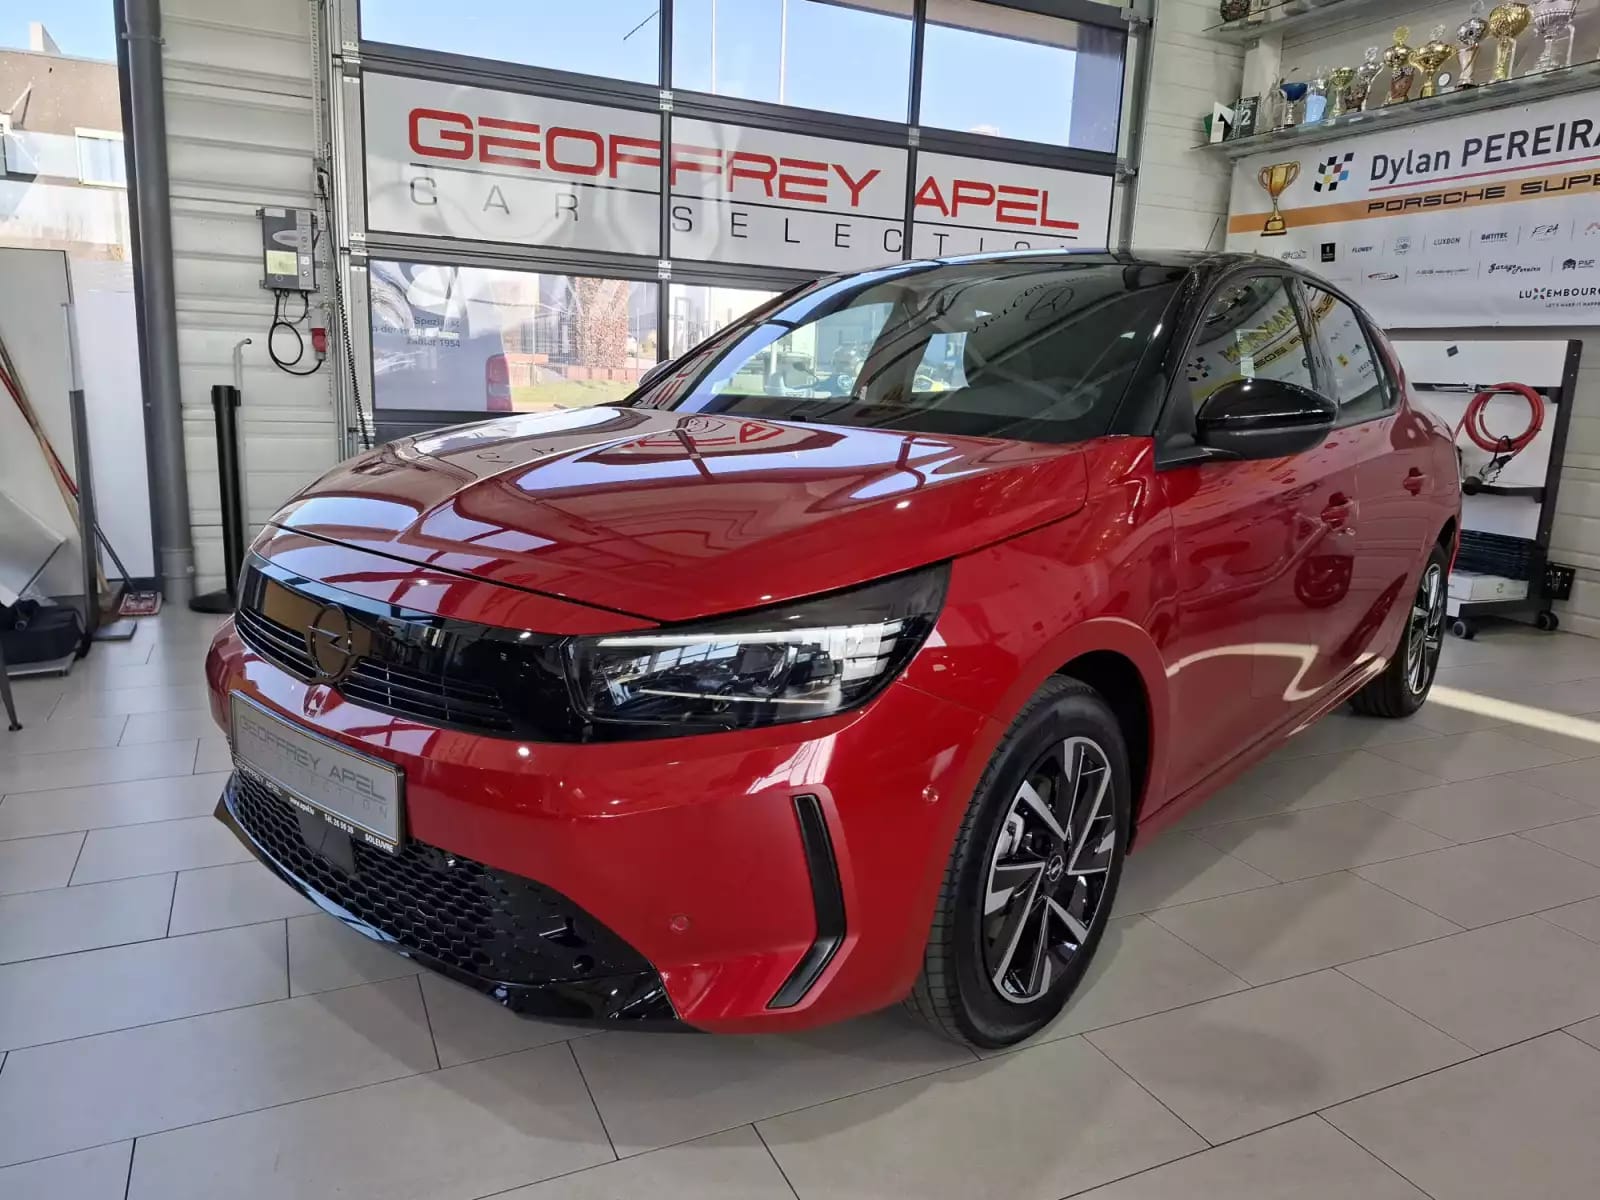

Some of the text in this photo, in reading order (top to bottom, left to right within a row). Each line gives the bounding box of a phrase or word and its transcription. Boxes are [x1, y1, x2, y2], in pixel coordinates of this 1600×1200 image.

[409, 108, 1079, 230] GEOFFREY APEL
[1370, 150, 1450, 184] Dylan
[410, 177, 1066, 257] CAR SELECTI
[1367, 186, 1506, 213] PORSCHE
[239, 714, 387, 802] GEOFFREY APEL
[365, 833, 394, 853] SOLEUVRE
